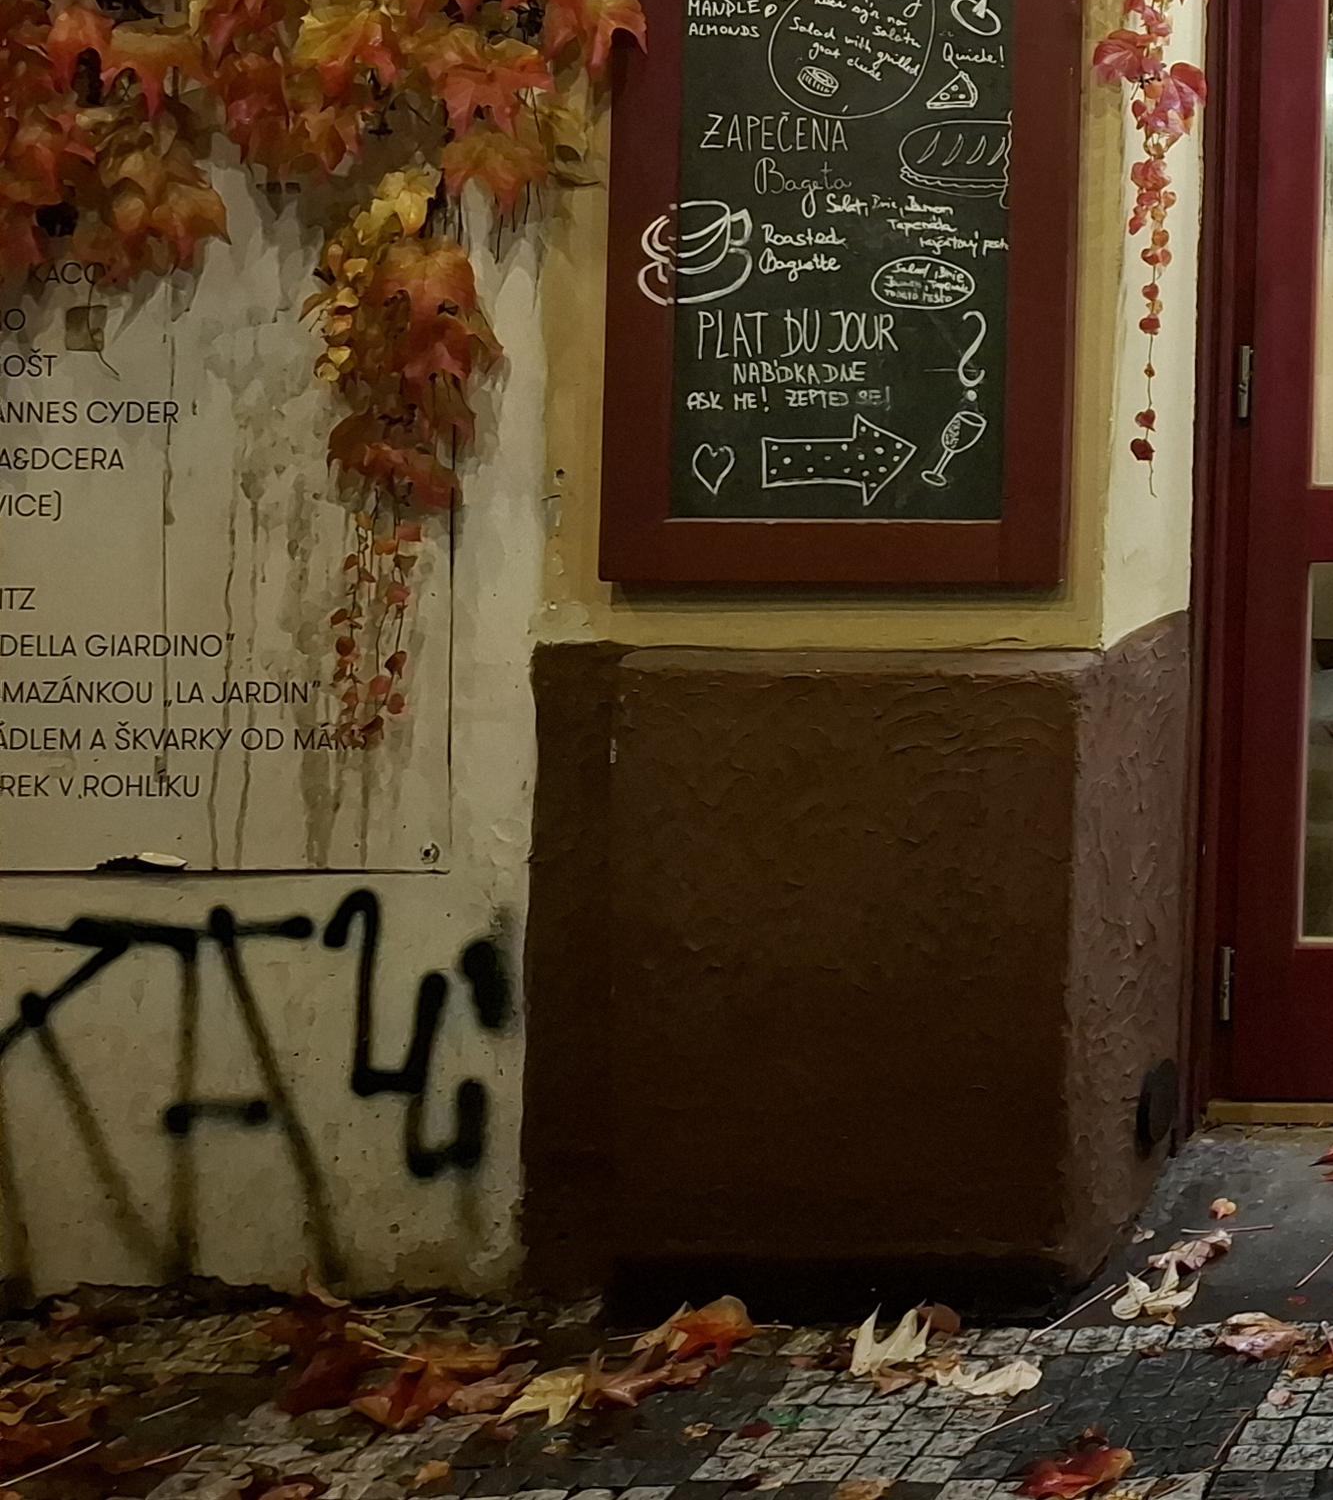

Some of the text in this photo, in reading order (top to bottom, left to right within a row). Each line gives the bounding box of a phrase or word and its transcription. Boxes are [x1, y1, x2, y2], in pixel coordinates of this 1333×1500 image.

[688, 23, 760, 38] ALMONDS
[700, 104, 849, 153] ZAPEČENÁ
[753, 156, 853, 219] Bageta
[761, 224, 848, 249] Roasted
[758, 250, 842, 282] Baguette
[697, 308, 899, 360] PLAT DU JOUR
[0, 347, 58, 378] OŠT
[733, 358, 868, 386] NABÍDKA DNE
[86, 400, 180, 425] CYDER
[686, 390, 724, 411] ASK
[0, 635, 77, 657] DELLA
[89, 728, 107, 751] A
[114, 721, 233, 751] ŠKVARKY
[240, 728, 285, 751] OD
